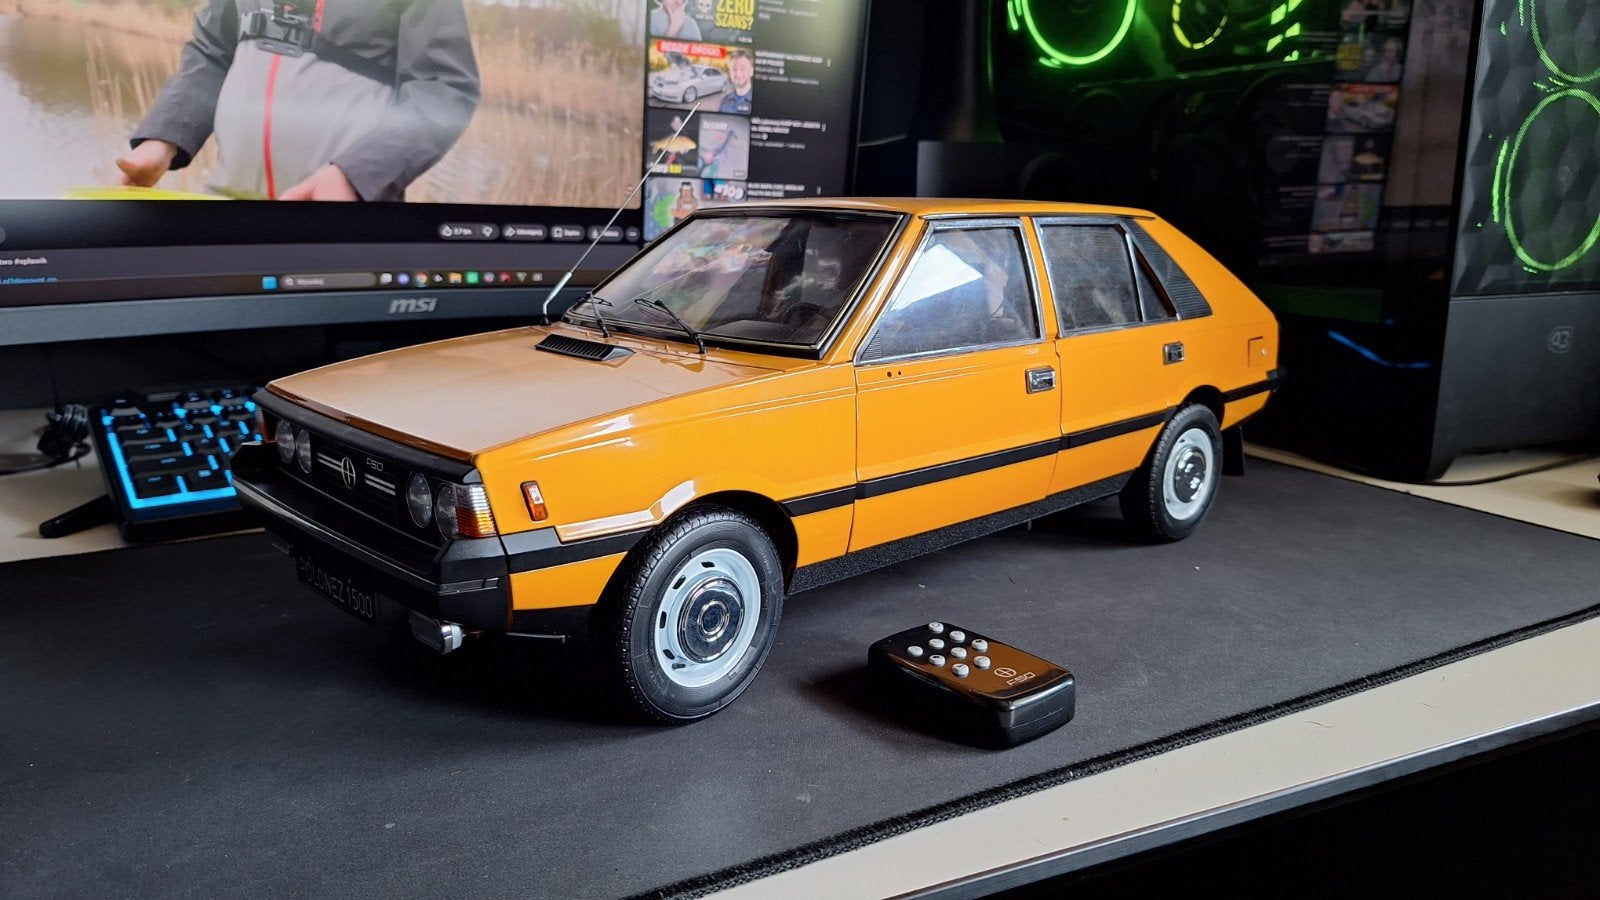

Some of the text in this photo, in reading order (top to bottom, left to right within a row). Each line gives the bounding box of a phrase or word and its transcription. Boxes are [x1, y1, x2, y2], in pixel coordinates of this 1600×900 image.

[715, 12, 754, 31] SZANS?
[389, 297, 438, 314] msi
[366, 457, 383, 472] FSO
[346, 584, 373, 618] 1500
[1006, 671, 1036, 687] FSO
